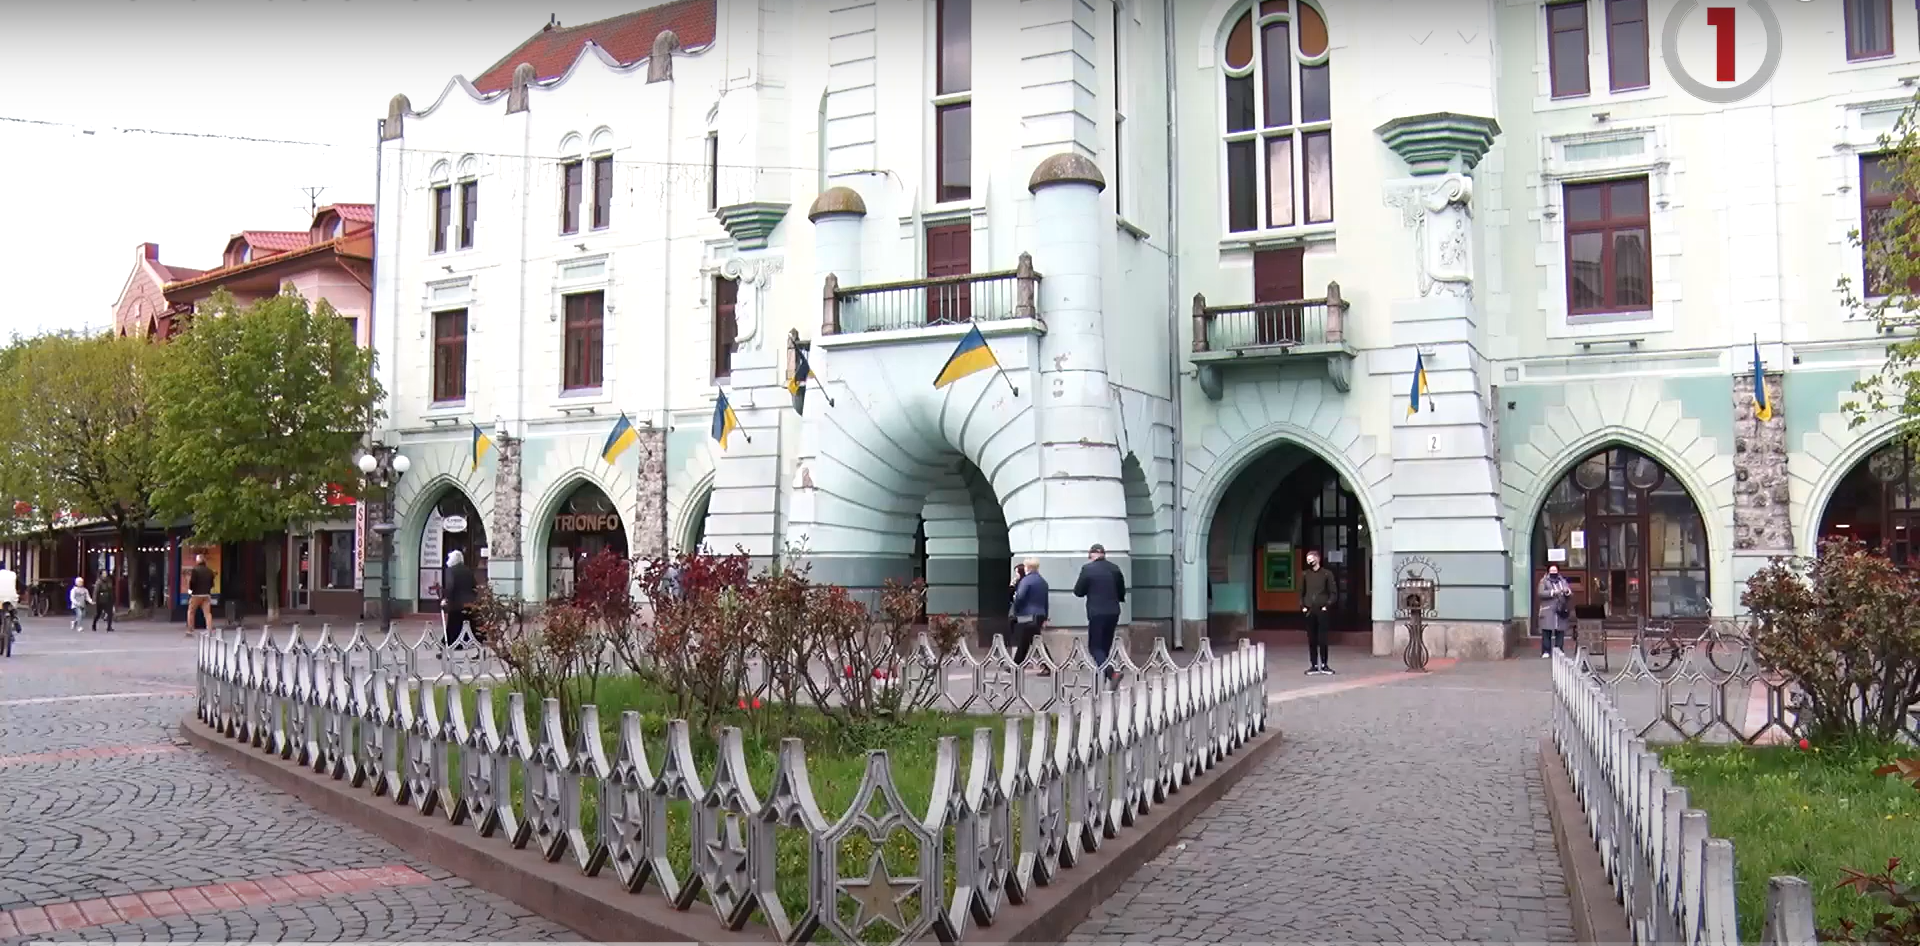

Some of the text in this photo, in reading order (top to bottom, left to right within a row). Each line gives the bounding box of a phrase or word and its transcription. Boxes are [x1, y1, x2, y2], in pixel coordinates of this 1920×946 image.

[1431, 436, 1437, 450] 2
[554, 513, 619, 532] TRIONFO
[357, 507, 365, 572] Shoes
